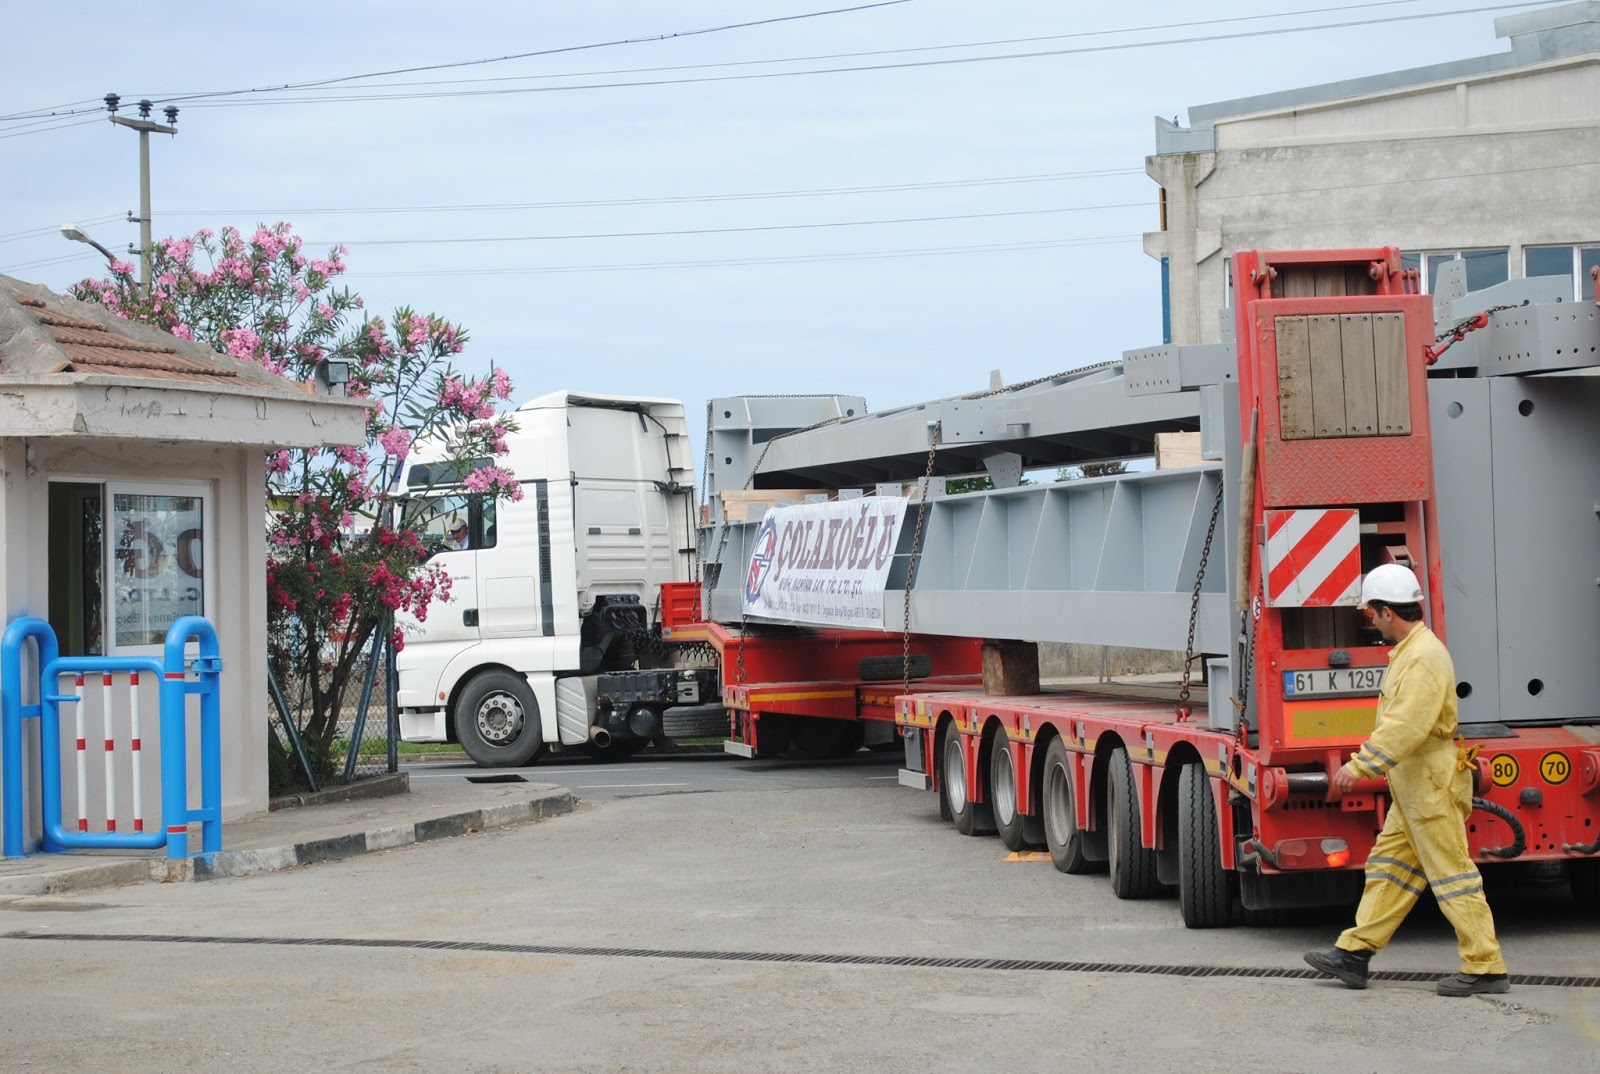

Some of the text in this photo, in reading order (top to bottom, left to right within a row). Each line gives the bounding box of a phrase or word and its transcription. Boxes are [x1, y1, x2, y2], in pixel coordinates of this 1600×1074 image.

[773, 503, 896, 582] ÇOLAKOĞLU
[1296, 673, 1313, 691] 61
[1328, 671, 1337, 690] K
[1348, 669, 1384, 689] 1297
[1493, 763, 1513, 778] 80
[1546, 761, 1566, 776] 70
